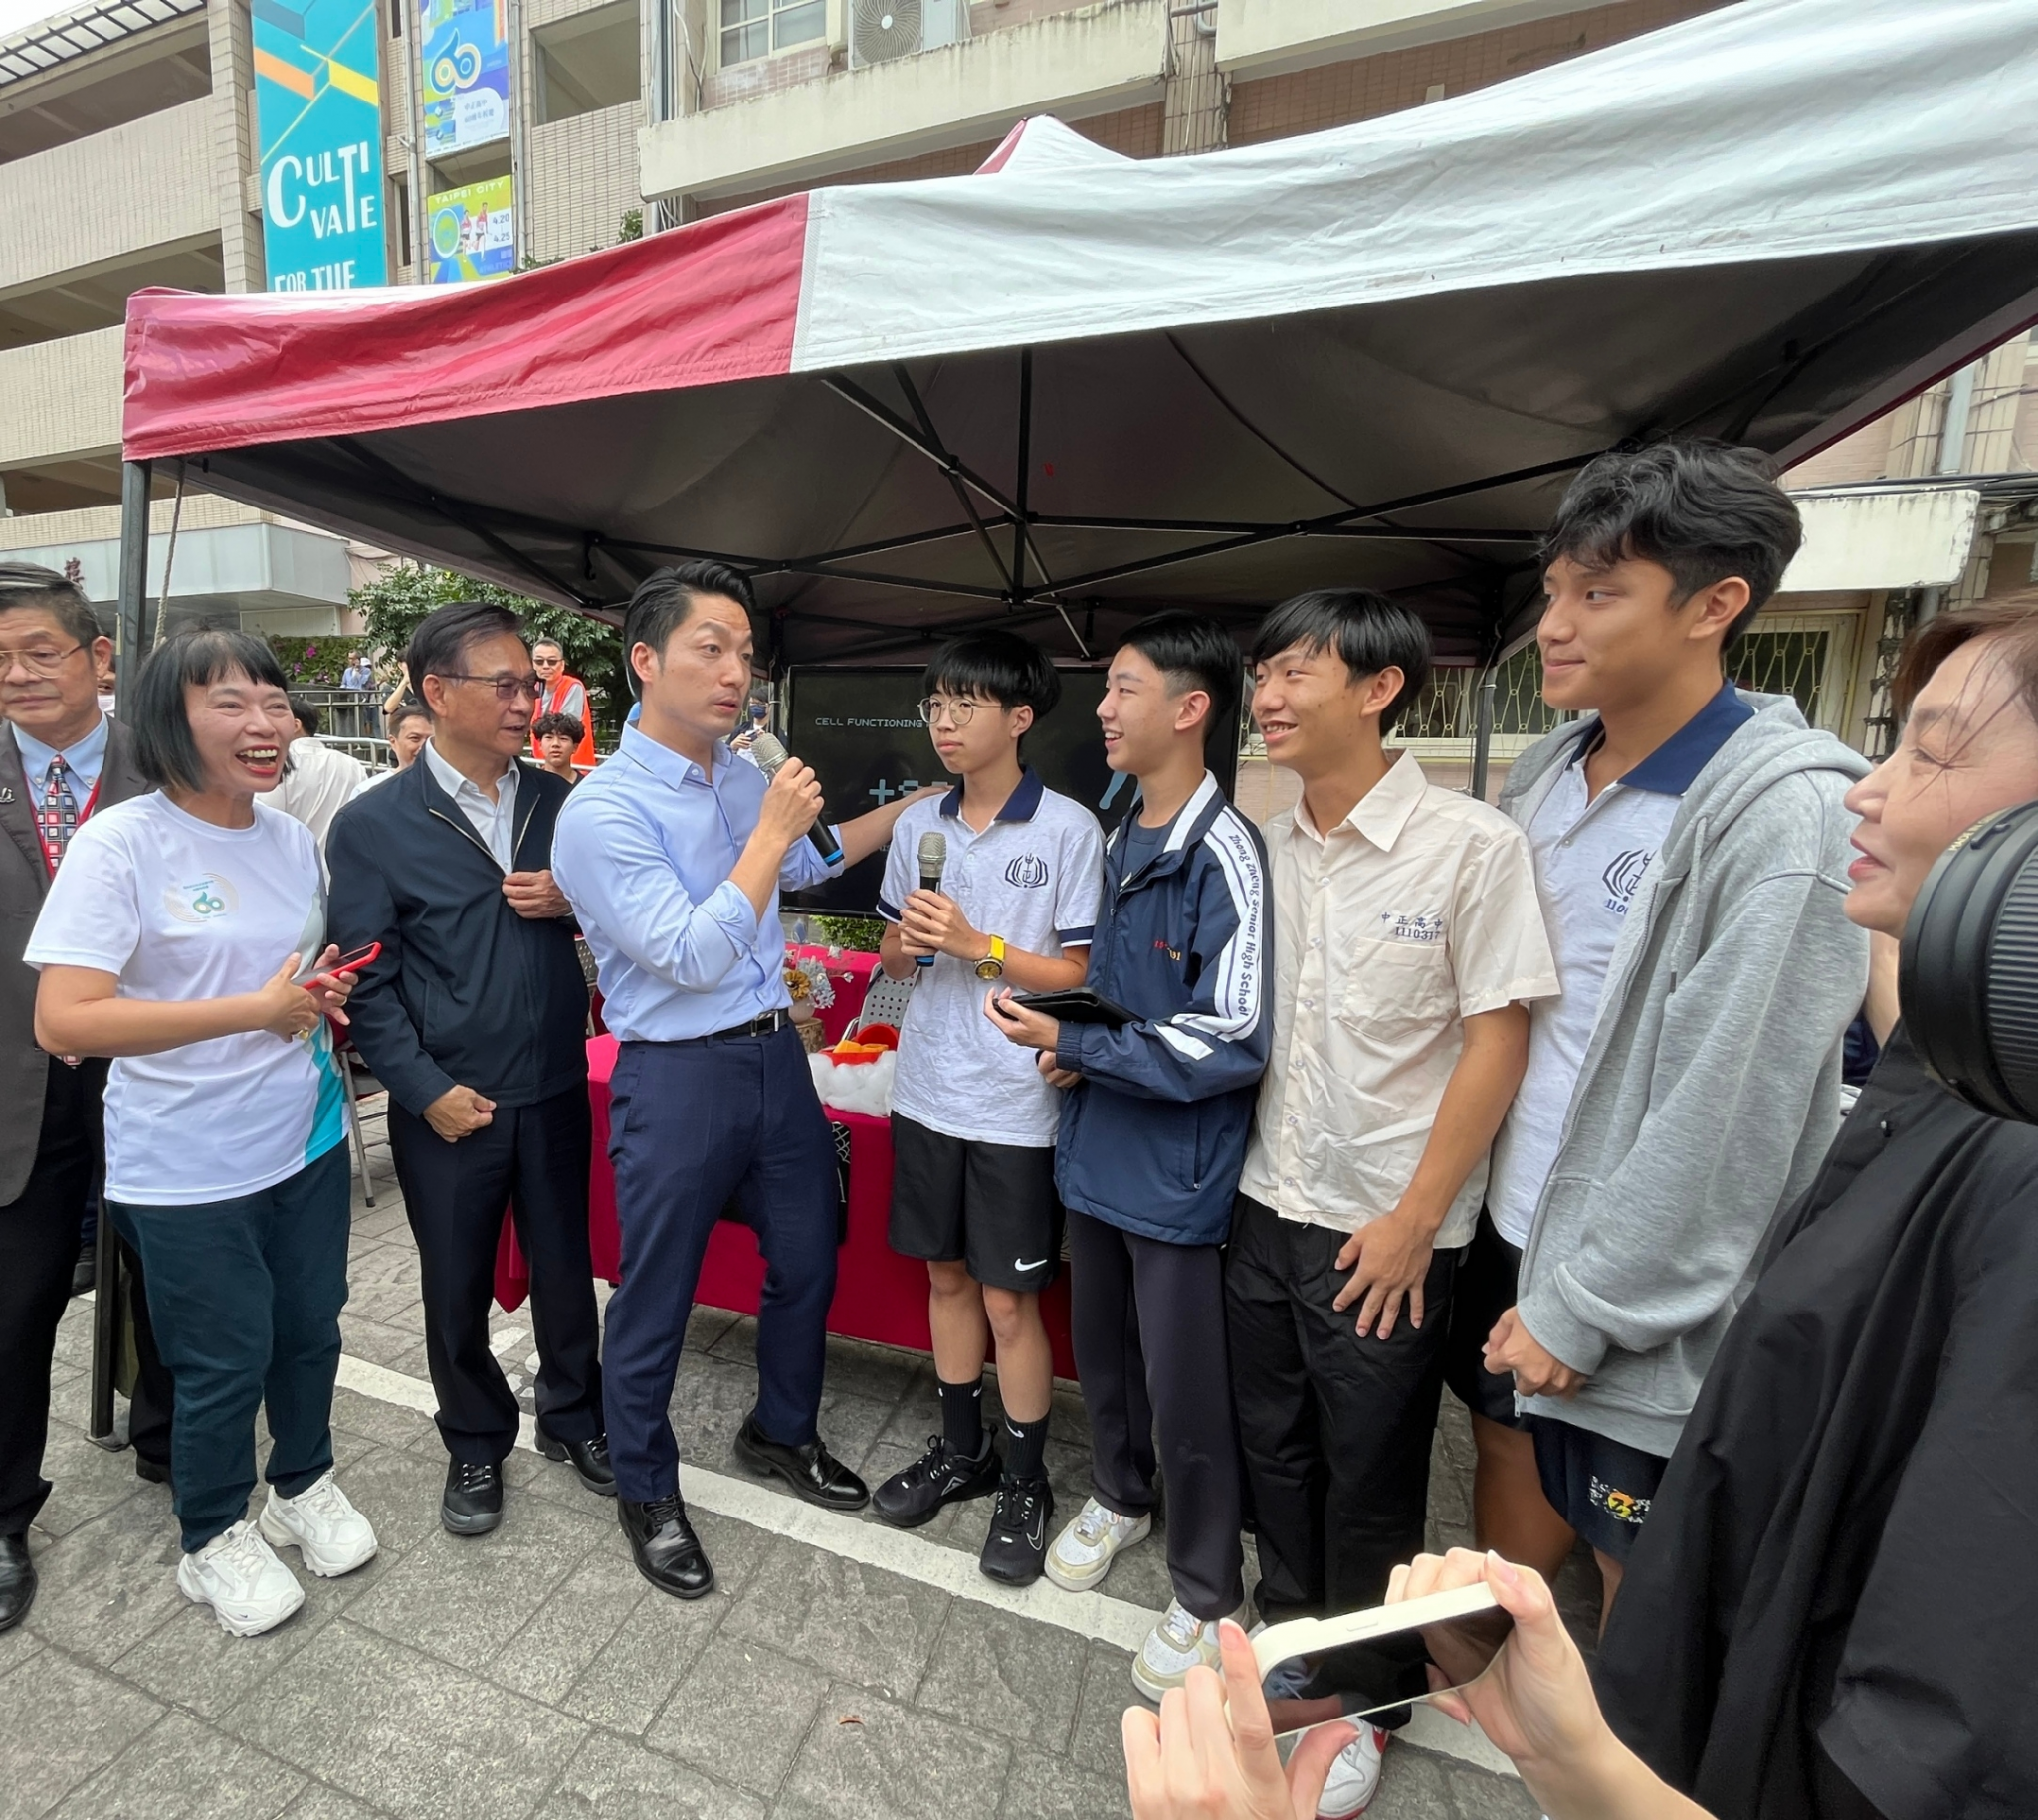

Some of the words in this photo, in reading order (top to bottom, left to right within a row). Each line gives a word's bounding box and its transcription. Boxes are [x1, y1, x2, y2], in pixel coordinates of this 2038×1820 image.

[435, 188, 472, 204] TAIPEI
[476, 180, 505, 194] CITY
[493, 213, 510, 225] 4.20
[493, 232, 510, 243] 4.25
[815, 717, 844, 726] CELL
[847, 718, 923, 728] FUNCTIONING
[1228, 834, 1251, 862] Zhong
[1245, 863, 1260, 896] Zheng
[1247, 899, 1260, 940] Senior
[1381, 911, 1443, 931] 中正高中
[1240, 941, 1256, 970] High
[1237, 972, 1253, 1017] School
